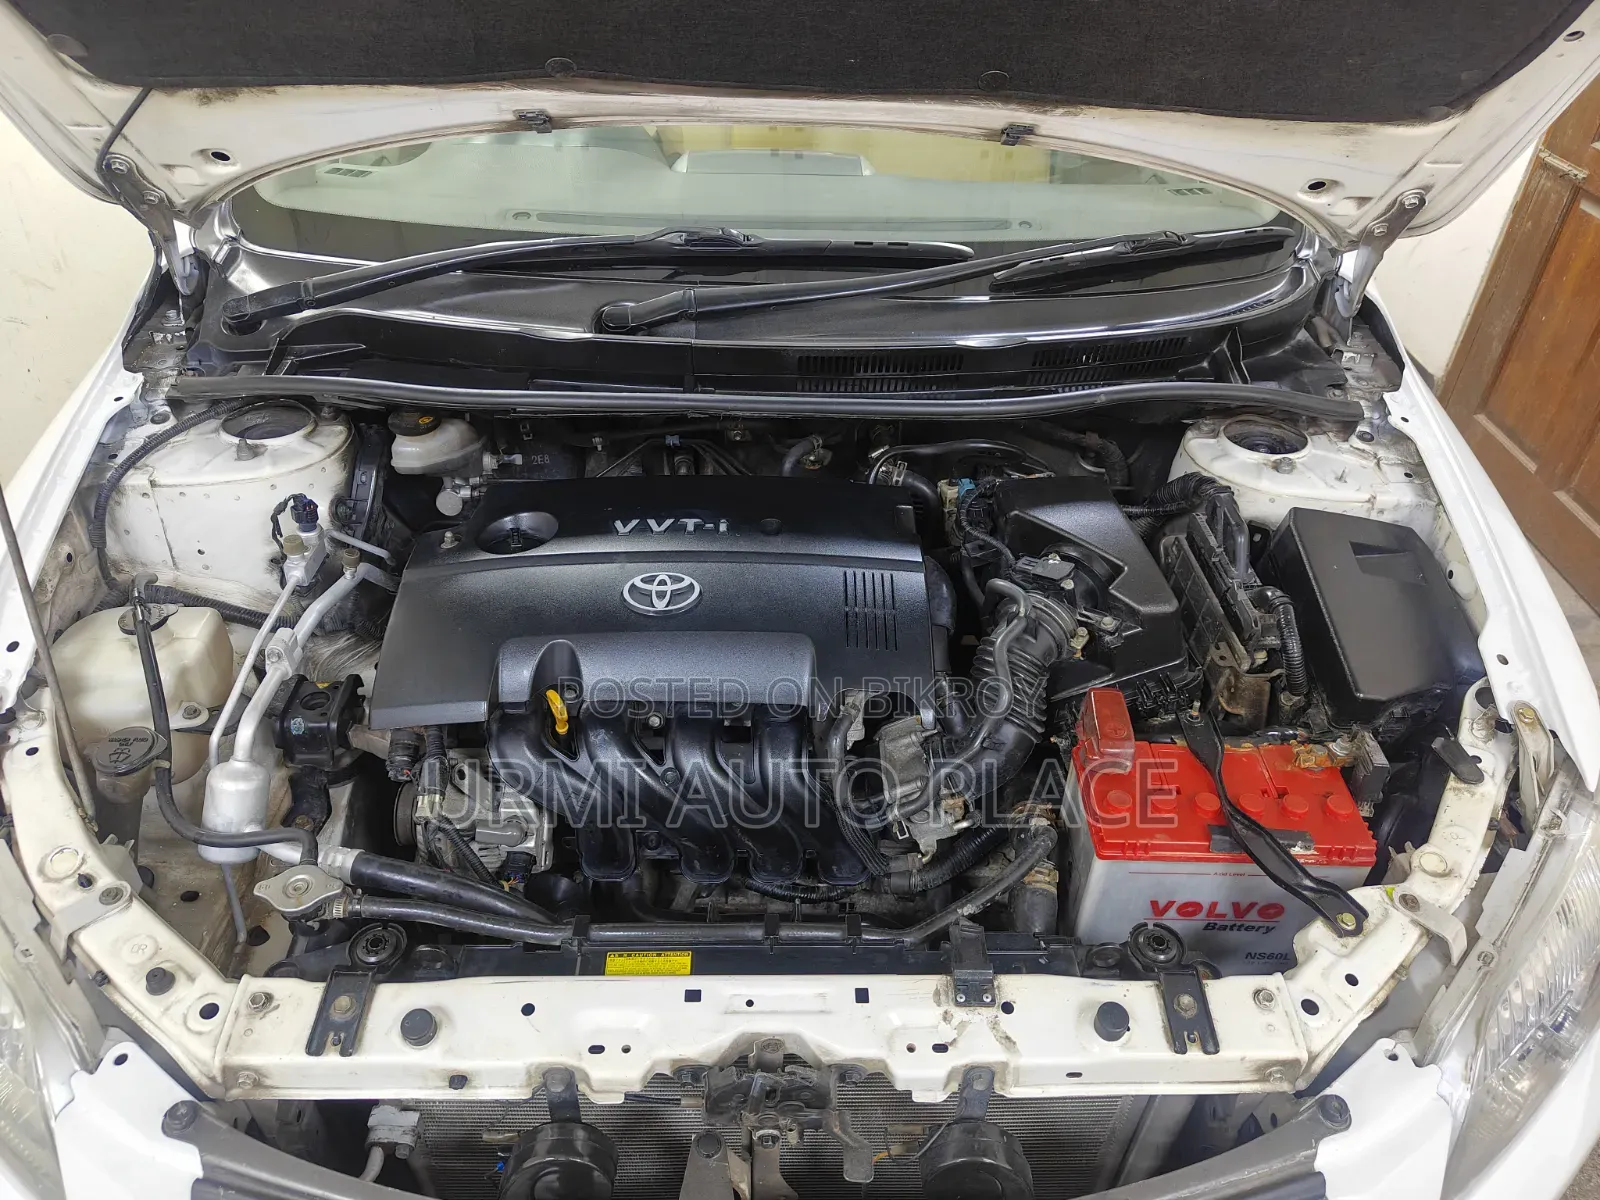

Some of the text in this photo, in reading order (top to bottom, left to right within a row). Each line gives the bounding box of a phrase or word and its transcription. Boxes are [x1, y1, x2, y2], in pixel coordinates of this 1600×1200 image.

[1150, 900, 1285, 920] VOLVO
[1202, 922, 1277, 935] Battery
[1244, 952, 1291, 961] NS60L
